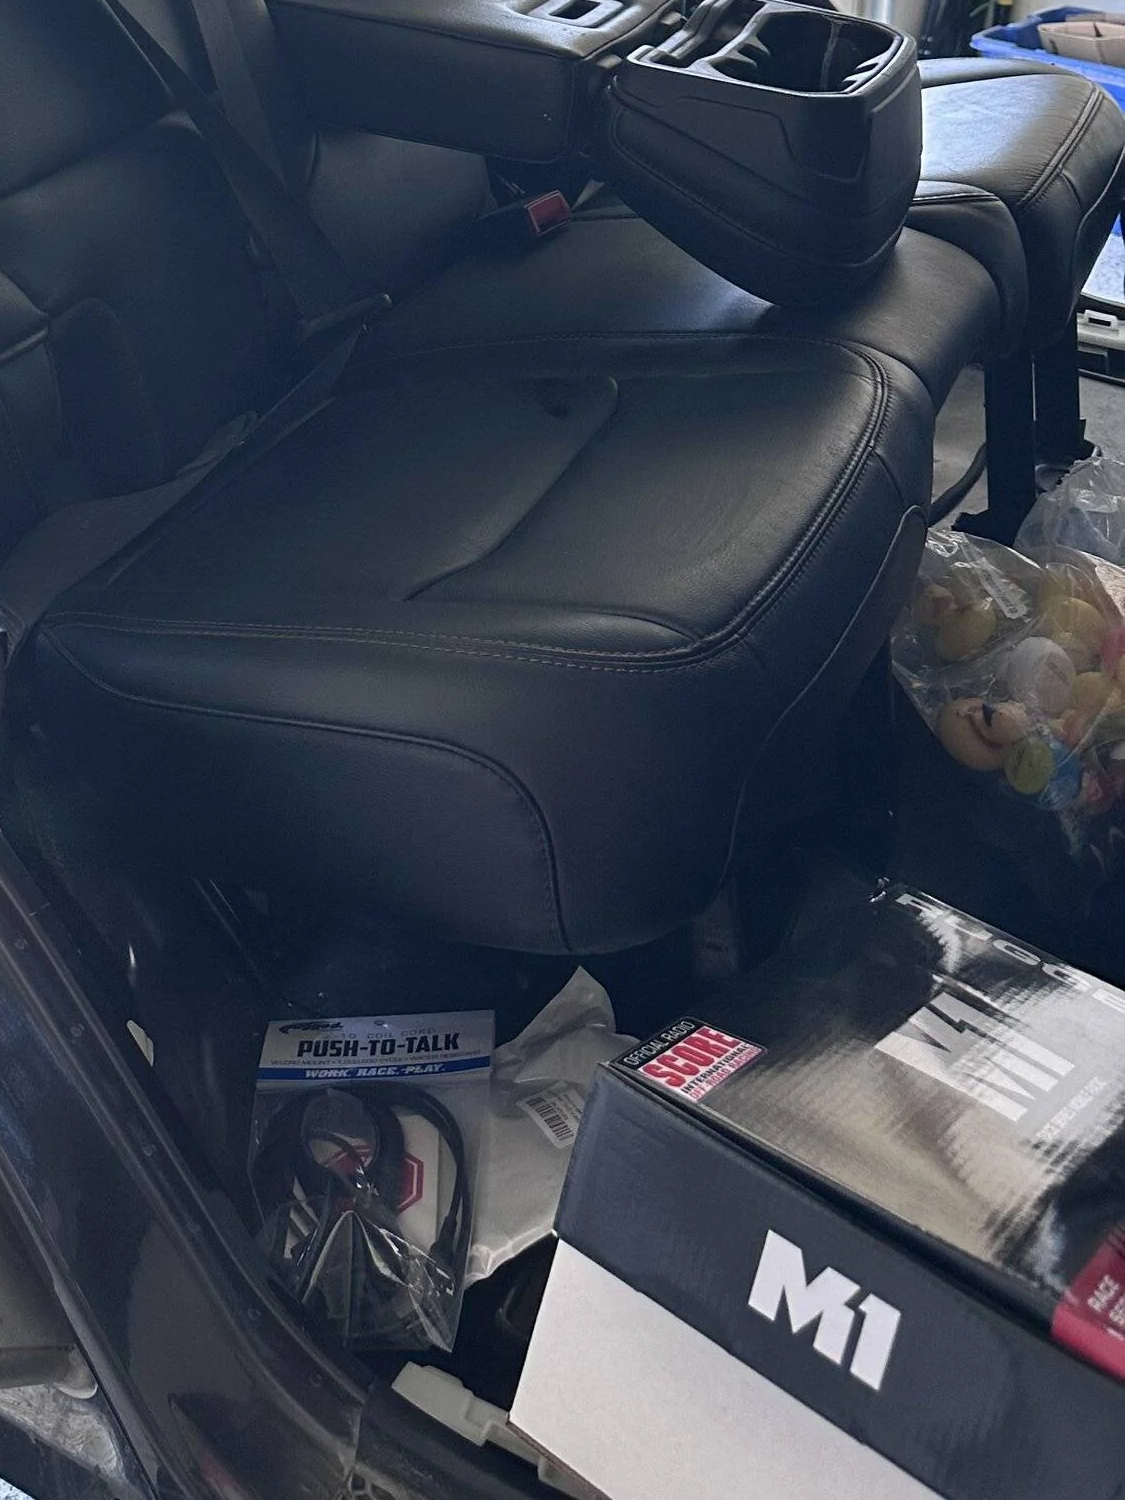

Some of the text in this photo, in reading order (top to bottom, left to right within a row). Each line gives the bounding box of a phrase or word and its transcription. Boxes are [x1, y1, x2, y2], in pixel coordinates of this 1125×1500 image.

[297, 1032, 460, 1058] PUSH-TO-TALK
[623, 1020, 696, 1066] OFFICIAL RADIO
[642, 1026, 742, 1088] SCORE
[681, 1043, 753, 1094] INTERNATIONAL
[748, 1229, 901, 1391] M1
